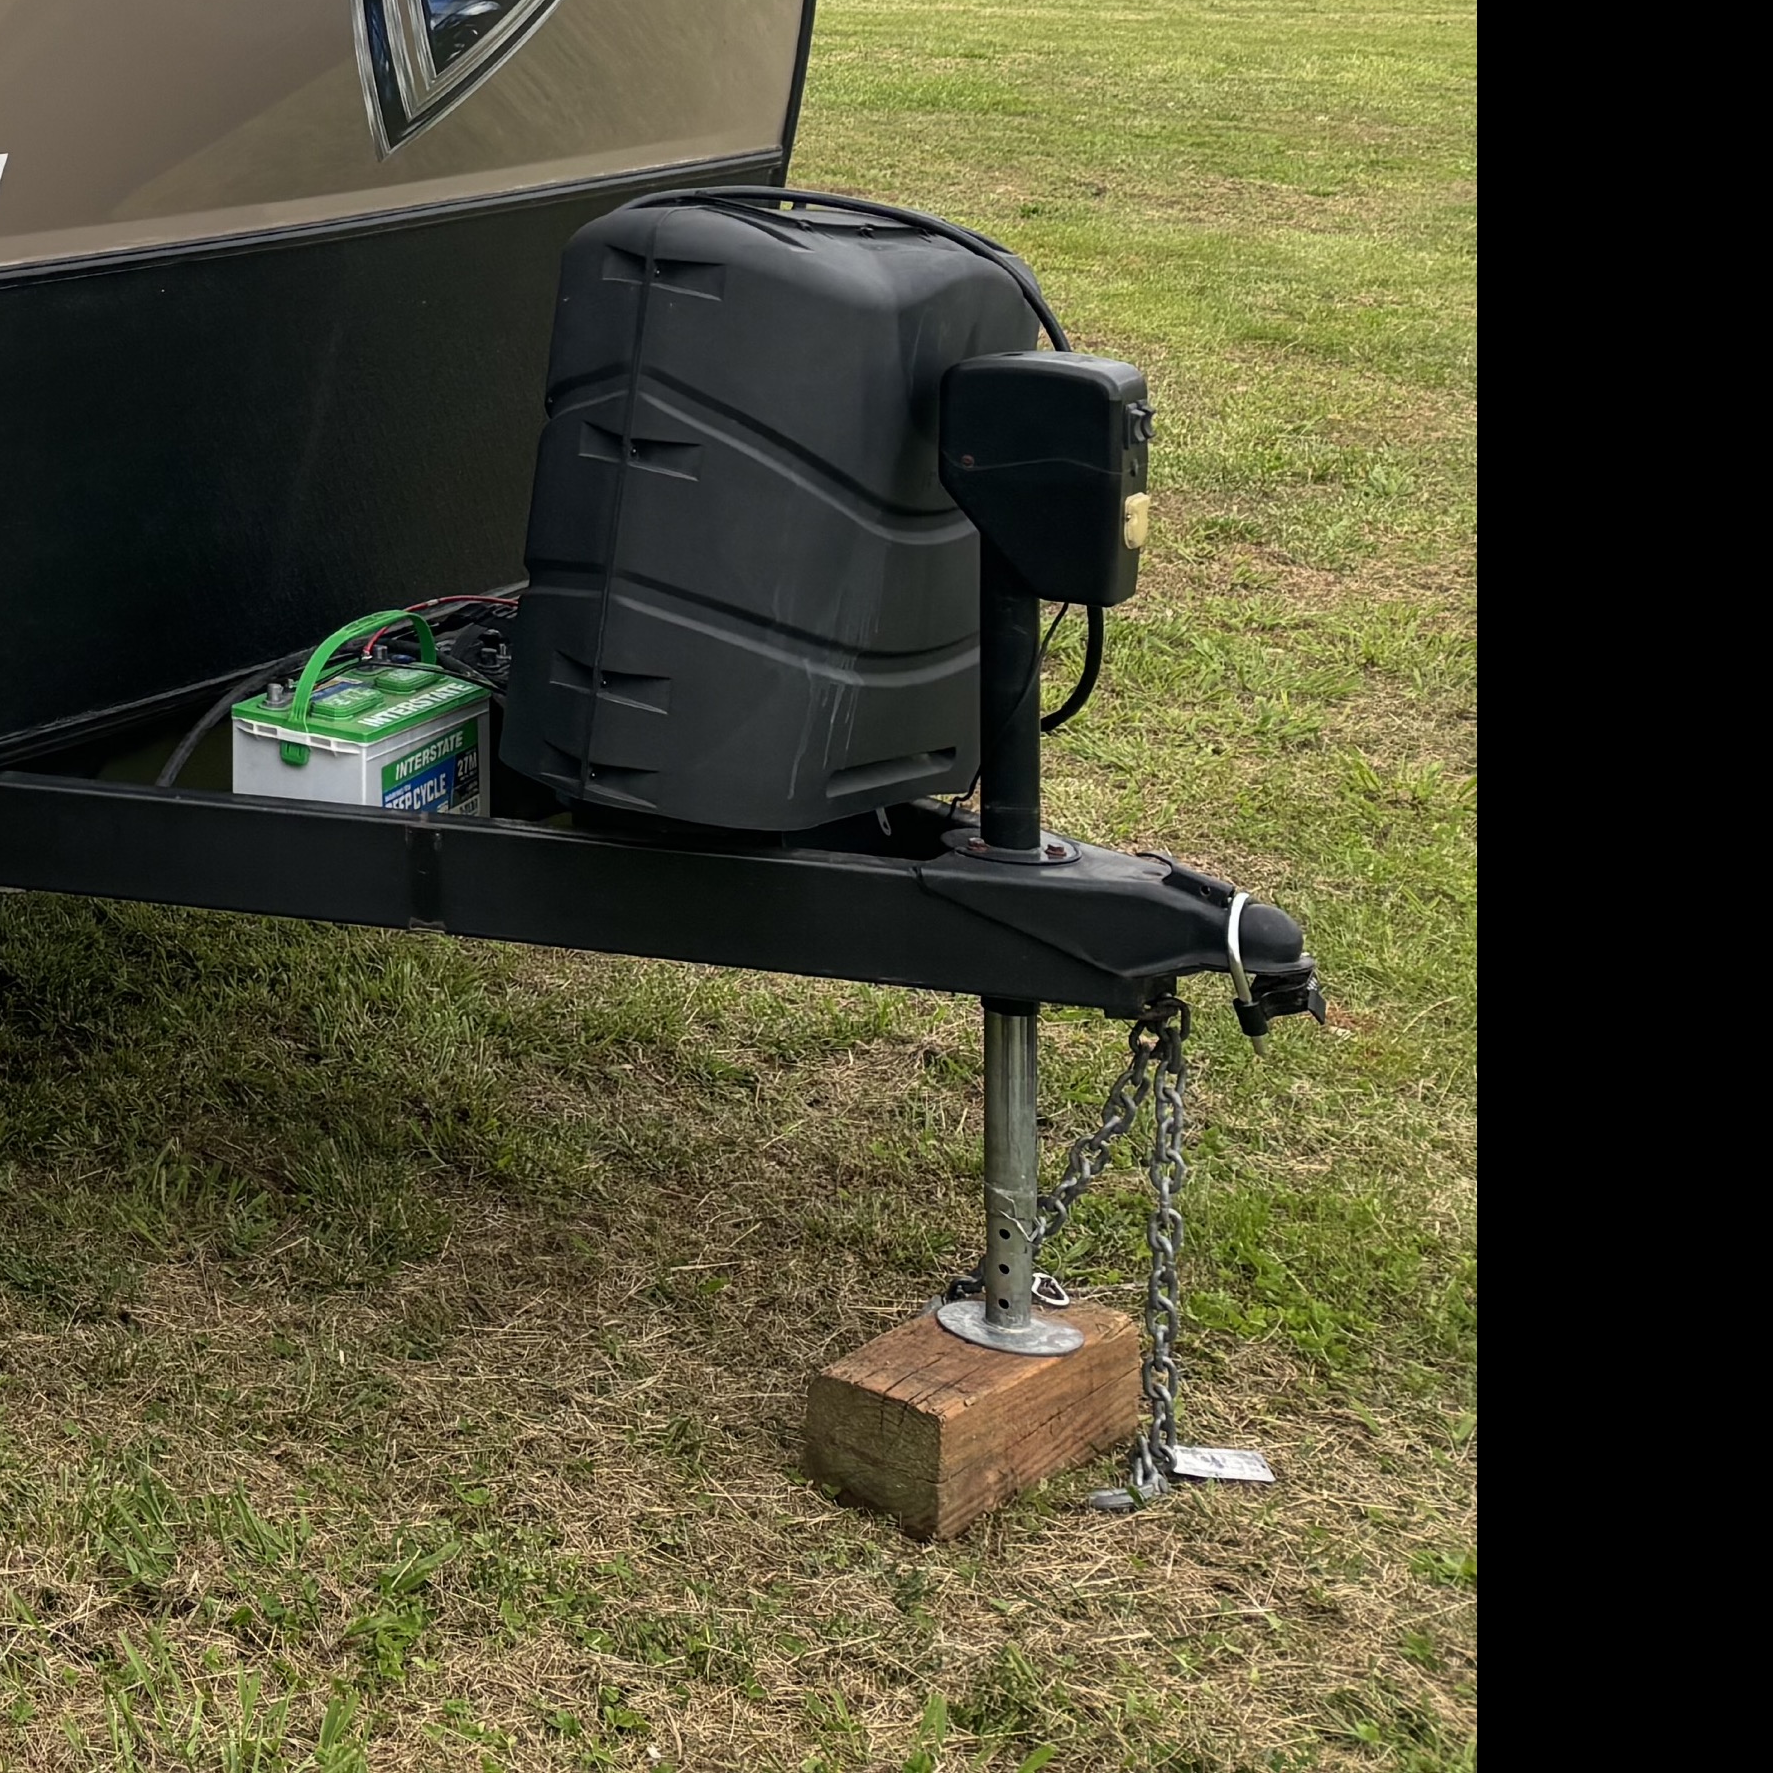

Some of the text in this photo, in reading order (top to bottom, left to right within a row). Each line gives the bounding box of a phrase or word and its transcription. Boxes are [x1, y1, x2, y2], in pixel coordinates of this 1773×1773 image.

[357, 682, 475, 728] INTERSTATE
[395, 730, 464, 781] INTERSTATE
[413, 773, 447, 811] CYCLE
